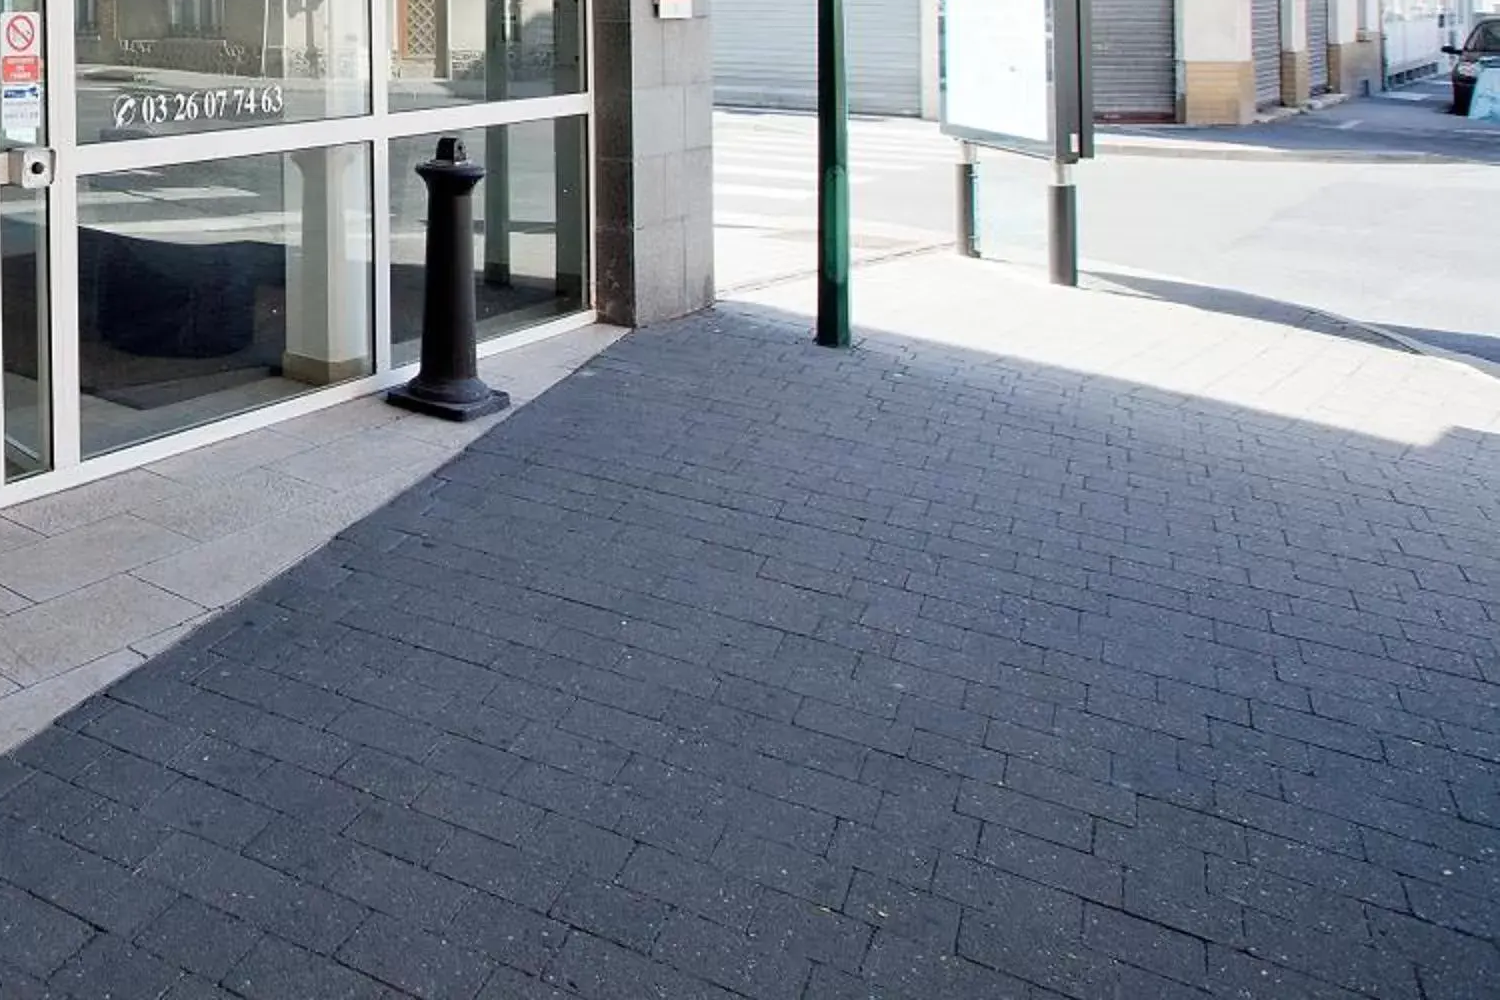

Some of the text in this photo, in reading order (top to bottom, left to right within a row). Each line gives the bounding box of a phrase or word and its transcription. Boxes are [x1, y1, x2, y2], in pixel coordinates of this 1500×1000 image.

[142, 84, 284, 124] 03 26 07 74 63
